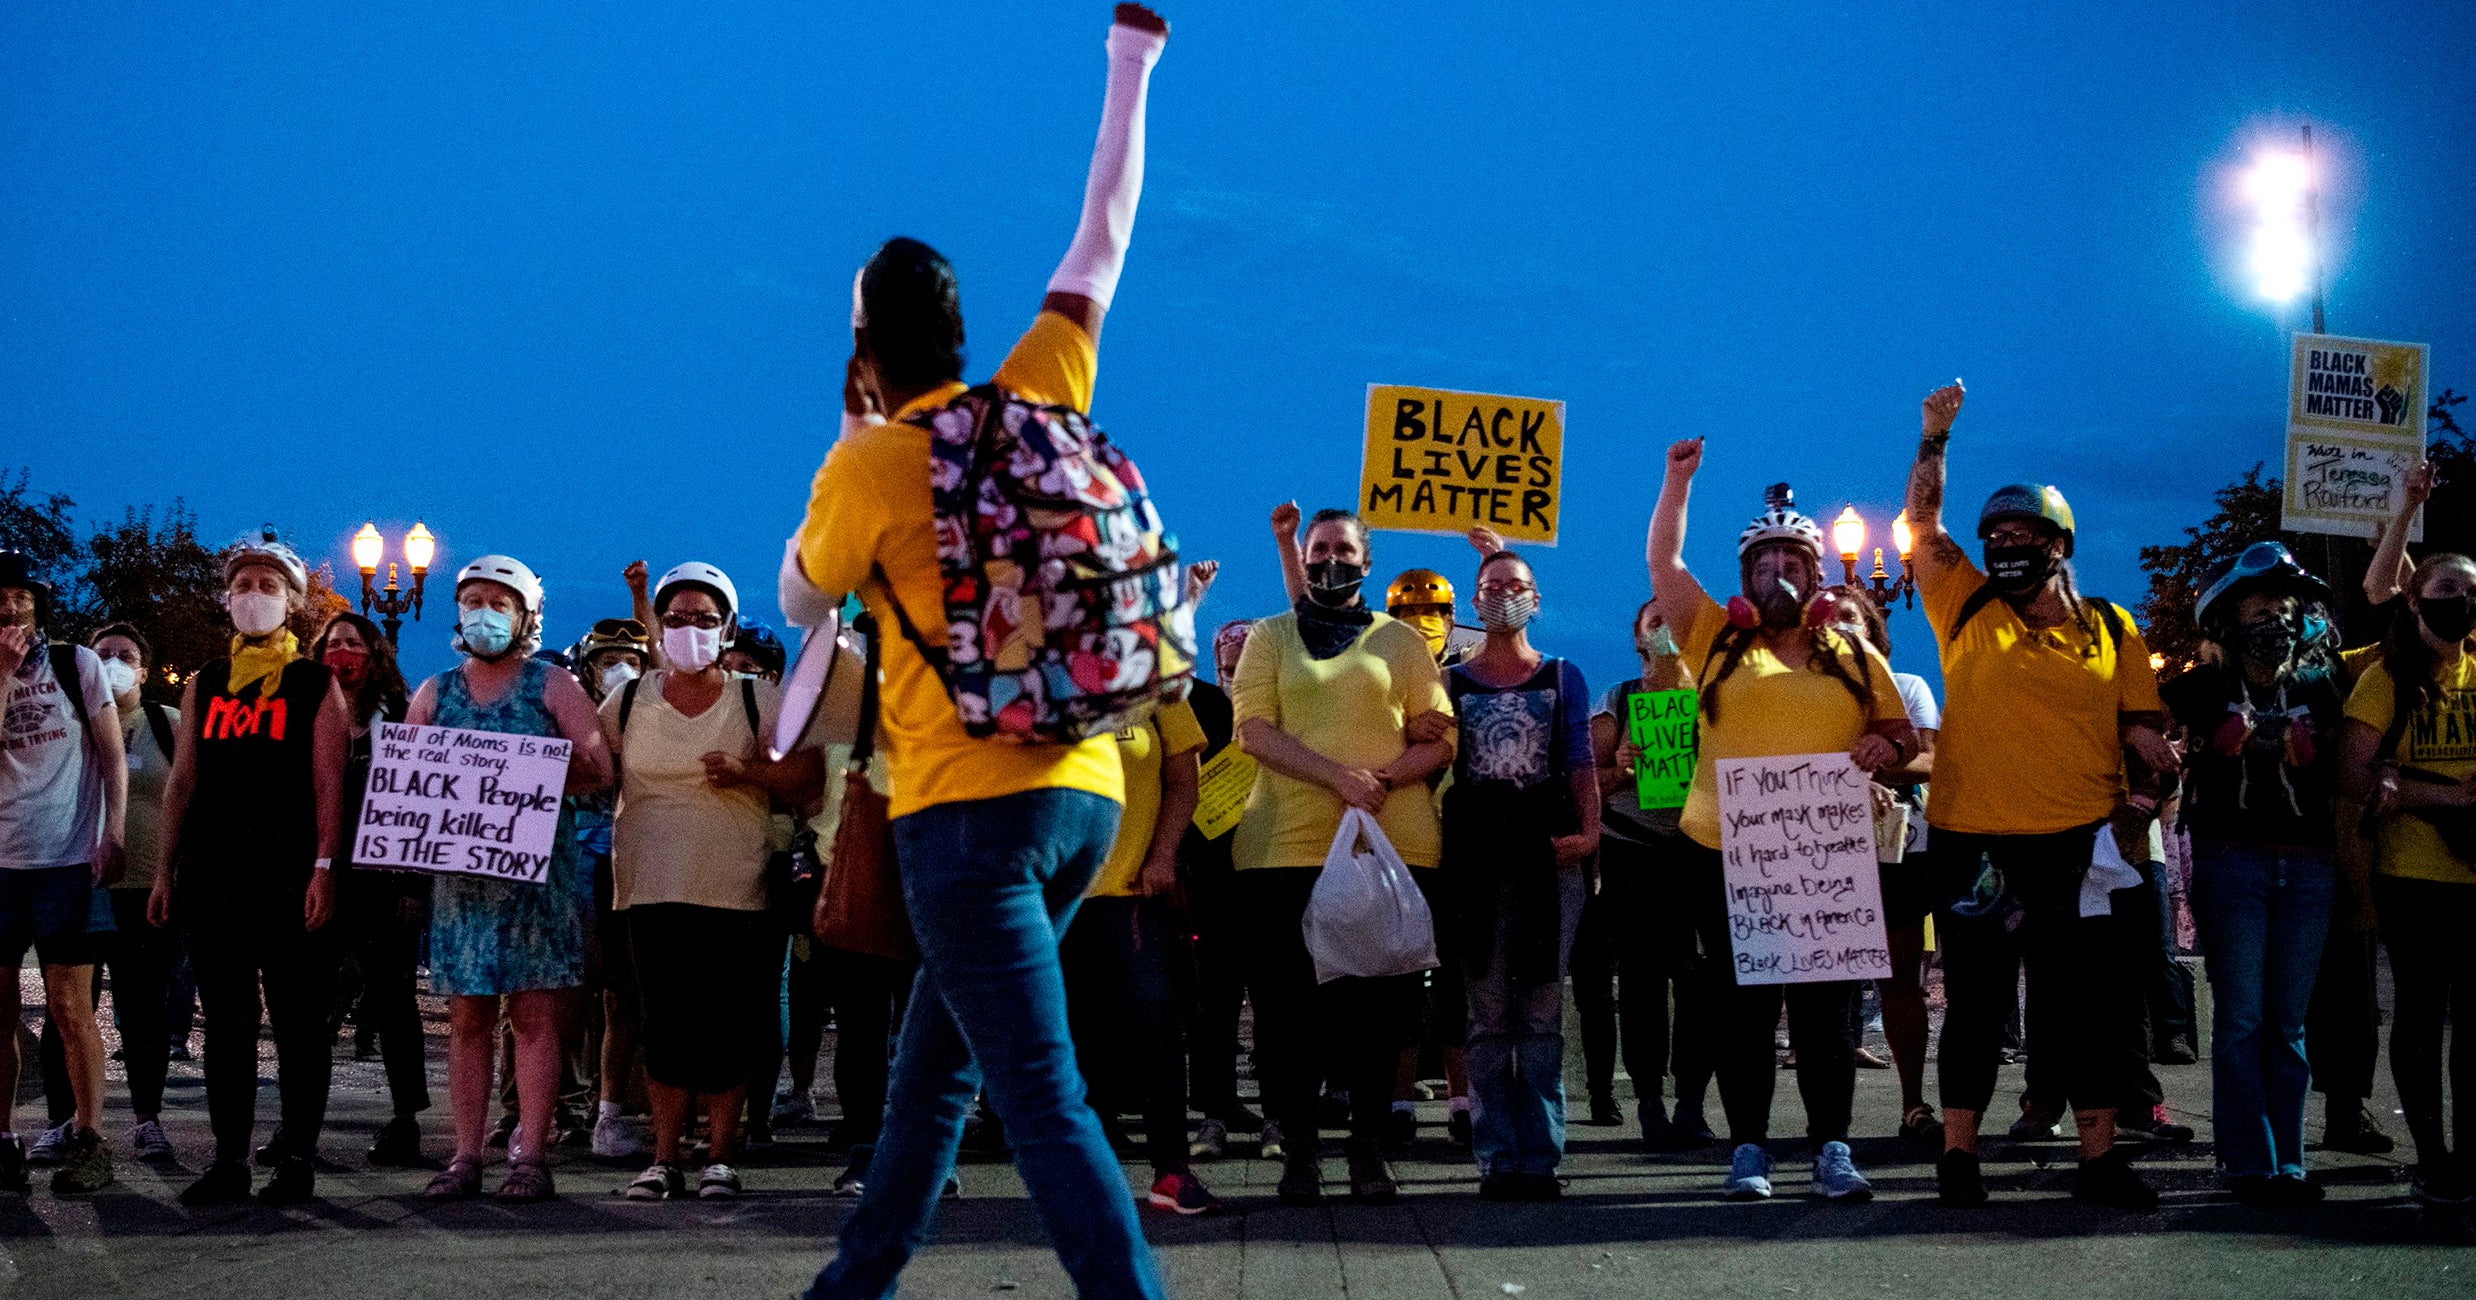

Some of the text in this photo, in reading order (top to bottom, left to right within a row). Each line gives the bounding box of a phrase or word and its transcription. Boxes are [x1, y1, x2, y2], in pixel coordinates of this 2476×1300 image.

[2309, 350, 2366, 375] BLACK
[2308, 372, 2374, 398] MAMAS
[2307, 394, 2374, 420] MATTER
[1393, 398, 1545, 455] BLACK
[1392, 447, 1552, 488] LIVES
[2351, 448, 2373, 461] in
[1369, 480, 1551, 532] MATTER
[14, 681, 57, 701] MITCH
[1634, 694, 1690, 721] BLAC
[27, 728, 67, 746] TRYING
[381, 725, 570, 760] Wall of Moms is not
[1638, 722, 1693, 750] LIVE
[382, 744, 510, 775] the real story.
[1640, 751, 1695, 780] MATT
[371, 767, 558, 816] BLACK People
[1725, 767, 1745, 795] IF
[364, 799, 517, 844] being killed
[360, 835, 549, 880] IS THE STORY
[1749, 843, 1789, 878] hard
[1795, 841, 1814, 857] to
[1729, 874, 1855, 914] Imagine being
